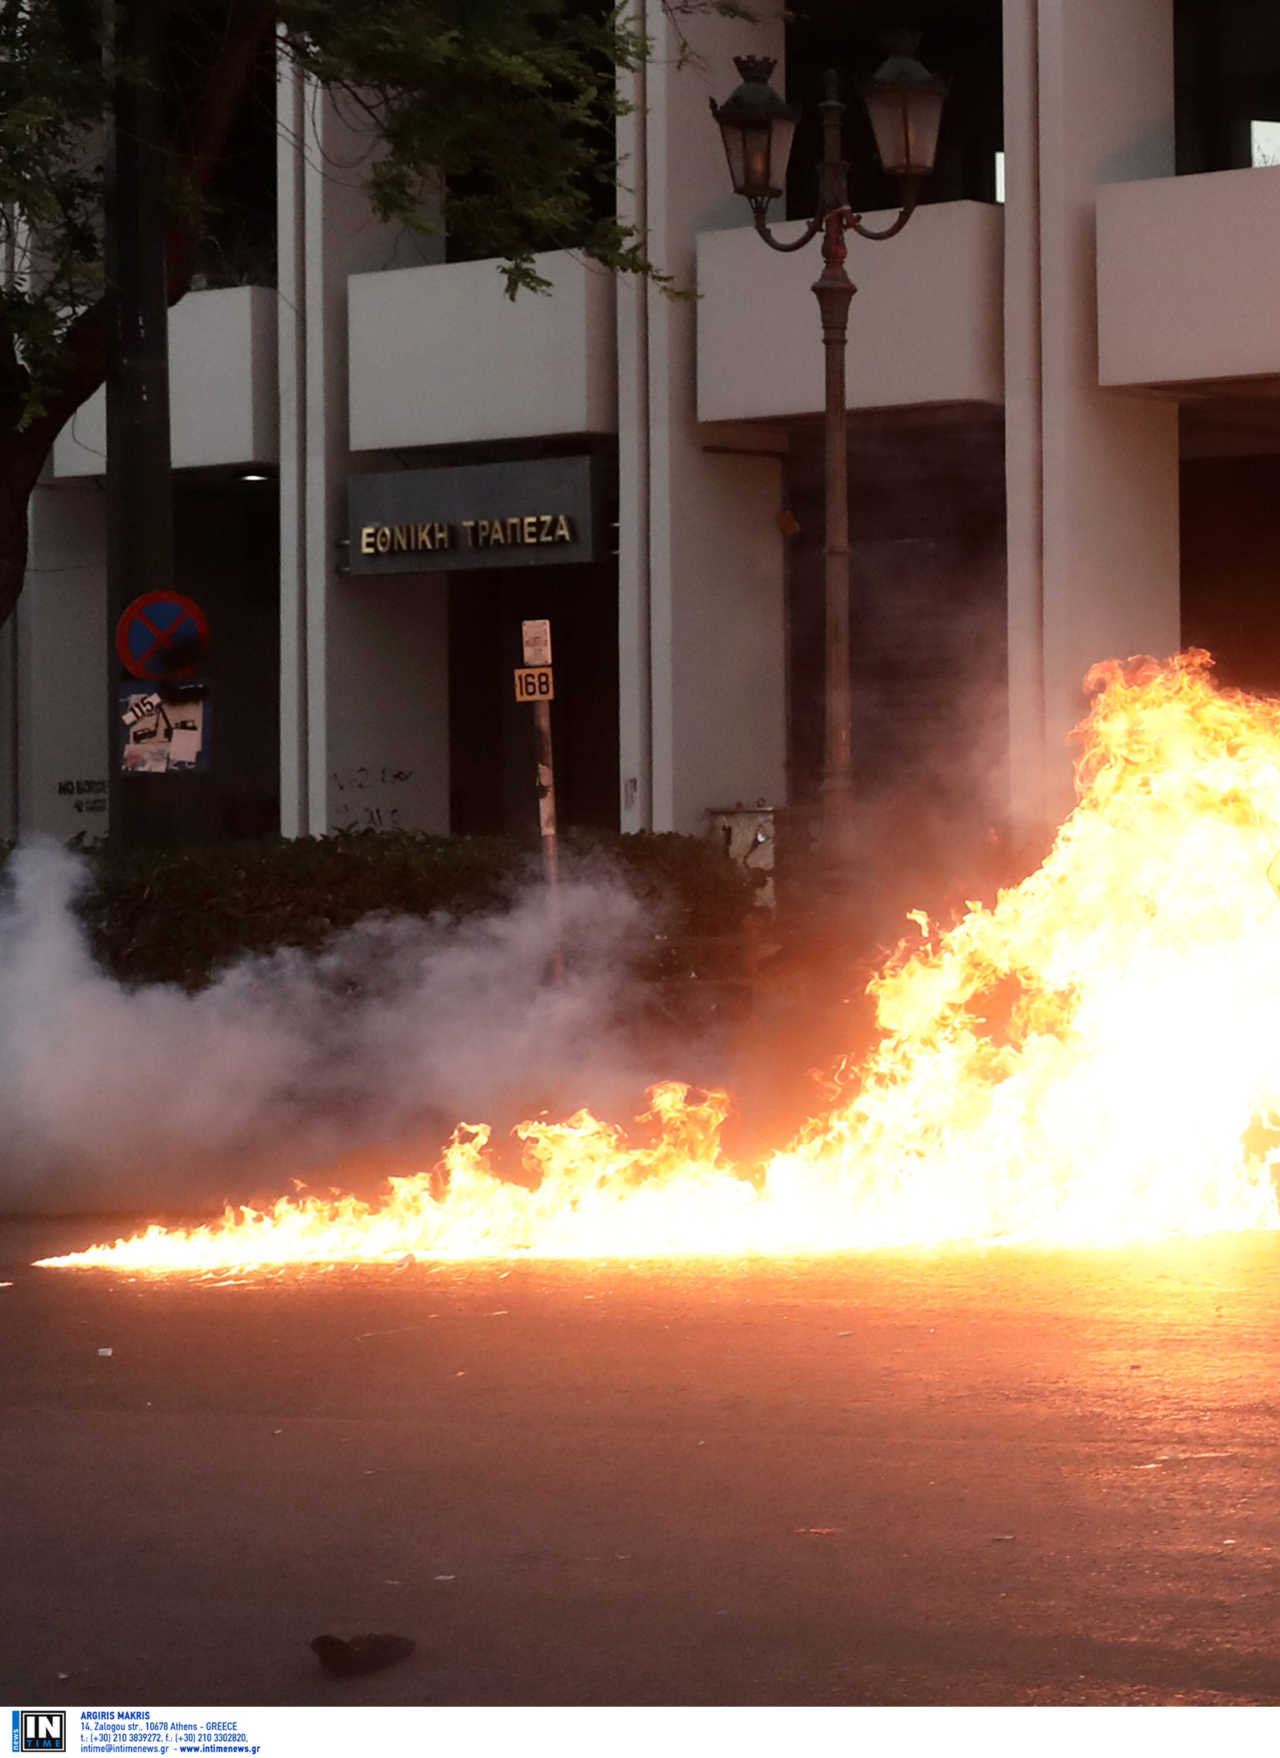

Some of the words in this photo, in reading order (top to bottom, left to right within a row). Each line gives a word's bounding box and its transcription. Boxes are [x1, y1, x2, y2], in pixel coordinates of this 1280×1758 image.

[360, 522, 449, 555] ΕΘΝΙΚΗ
[461, 513, 571, 548] ΤΡΑΠΕΖΑ
[517, 672, 549, 697] 168
[130, 696, 154, 721] 115
